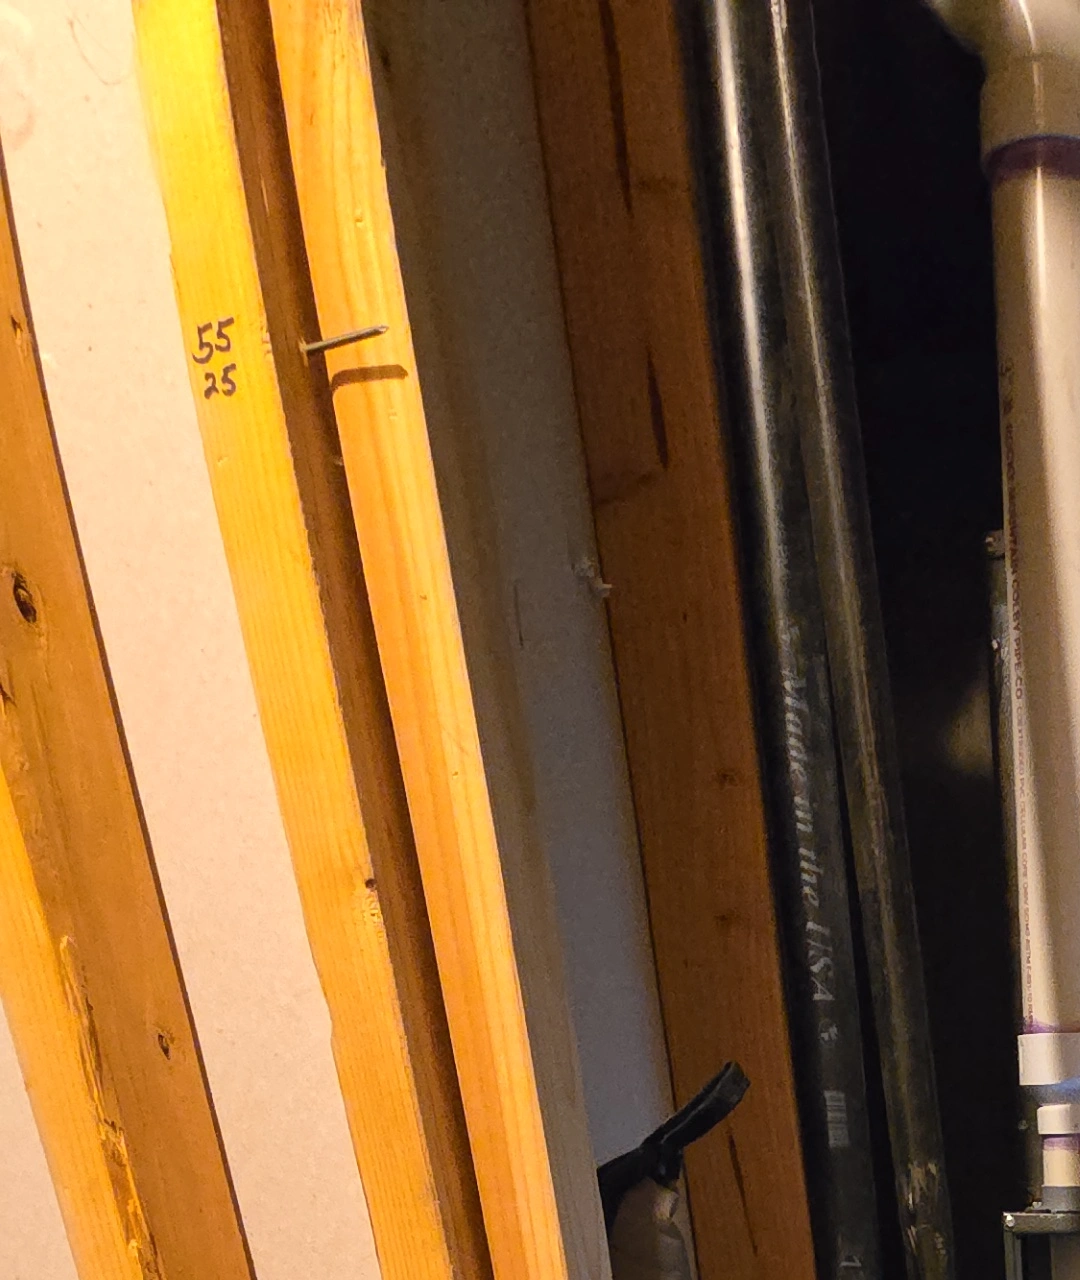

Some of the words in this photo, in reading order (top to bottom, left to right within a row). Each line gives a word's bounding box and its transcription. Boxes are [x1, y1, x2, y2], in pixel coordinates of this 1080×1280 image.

[192, 317, 235, 364] 55
[204, 363, 237, 399] 25
[1011, 579, 1021, 631] COLBY
[1013, 637, 1022, 672] PIPE
[806, 919, 835, 1003] USA
